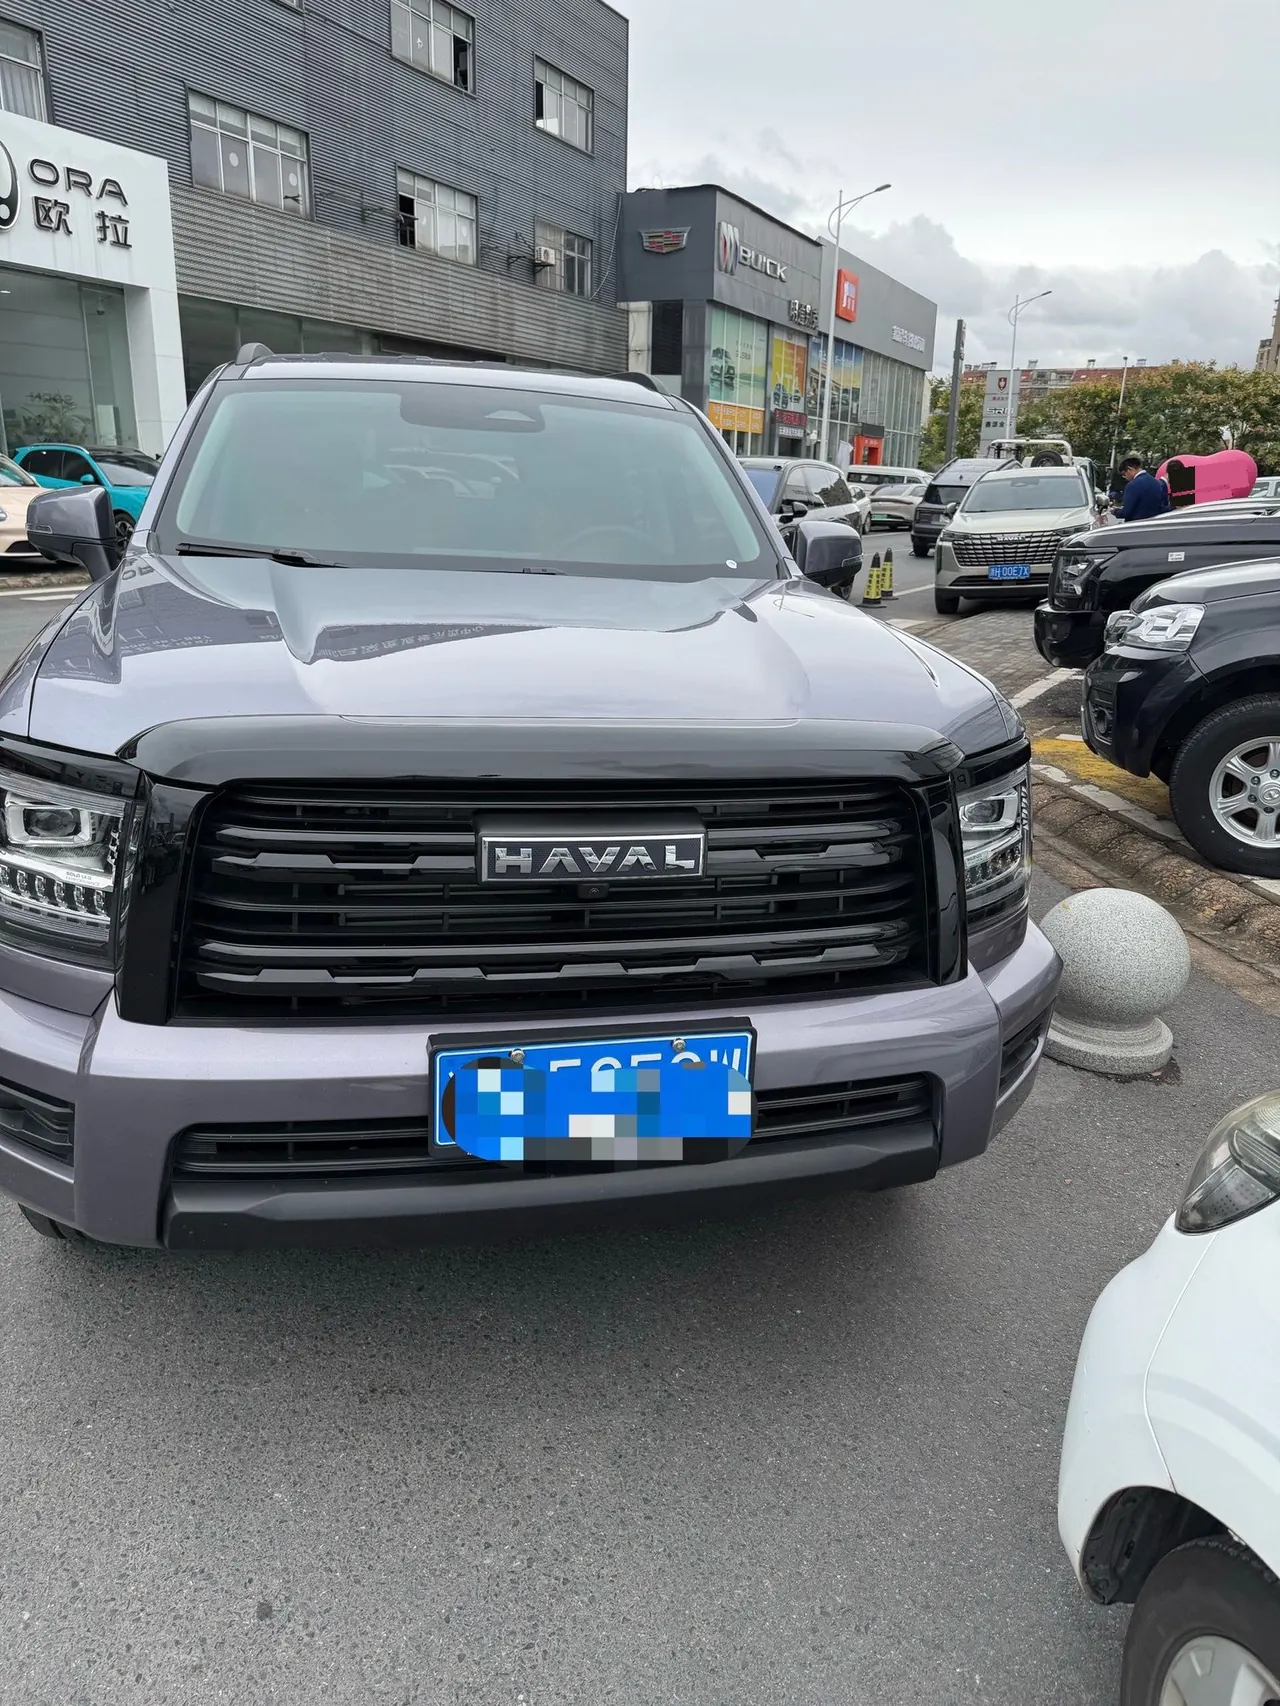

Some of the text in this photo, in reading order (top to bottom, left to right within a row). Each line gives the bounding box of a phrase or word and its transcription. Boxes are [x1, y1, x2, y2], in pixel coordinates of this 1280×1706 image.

[29, 158, 128, 206] ORA
[32, 195, 132, 249] 欧拉
[739, 245, 788, 283] BUICK
[494, 845, 696, 874] HAVAL
